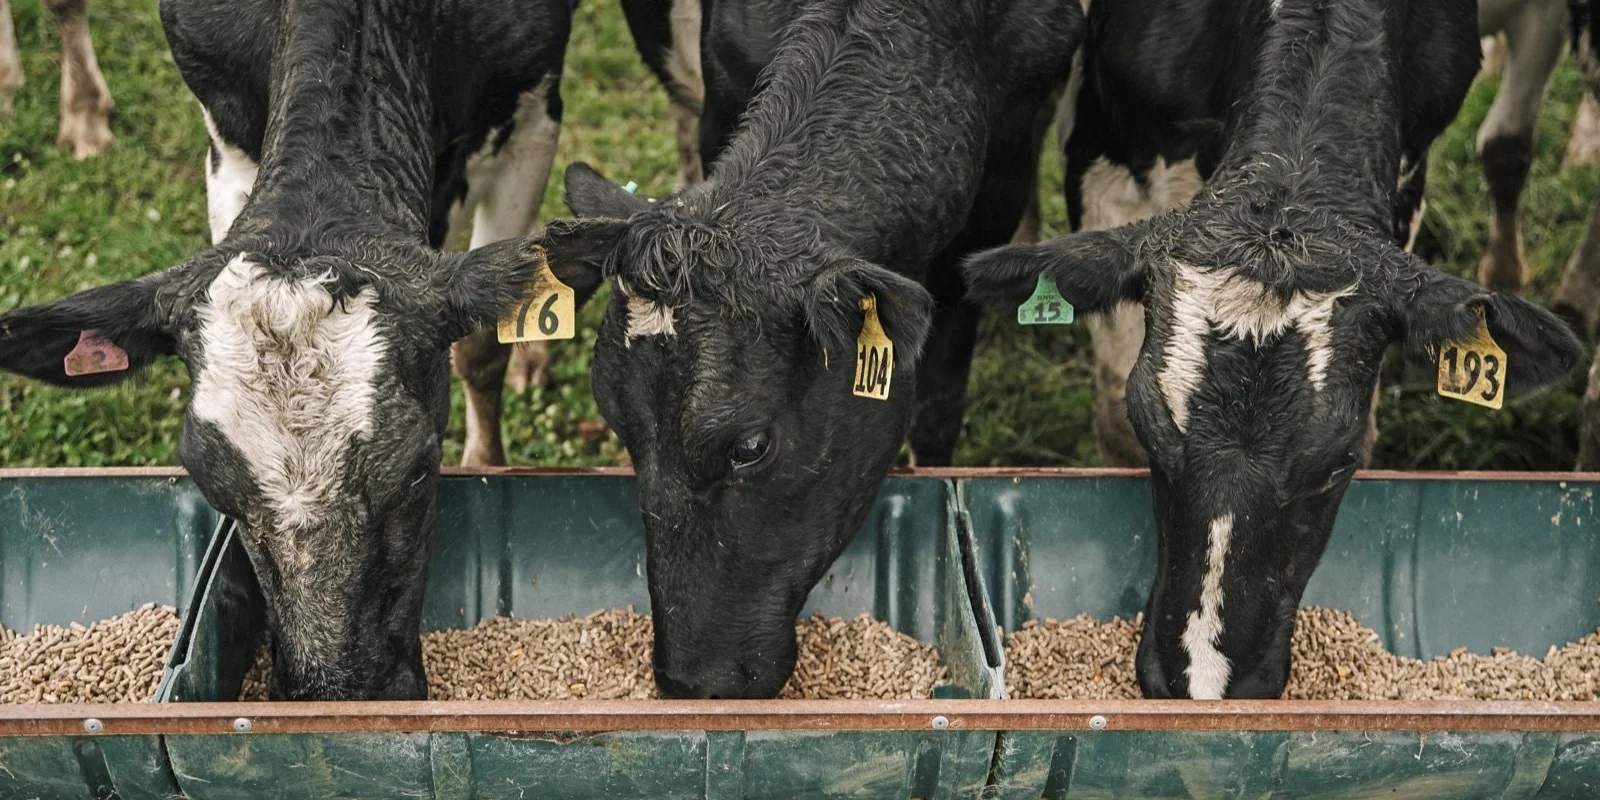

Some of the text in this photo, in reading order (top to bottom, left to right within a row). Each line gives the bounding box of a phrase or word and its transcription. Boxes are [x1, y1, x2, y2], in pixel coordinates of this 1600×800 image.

[1034, 302, 1061, 322] 15
[855, 345, 889, 395] 104
[1442, 347, 1500, 401] 193
